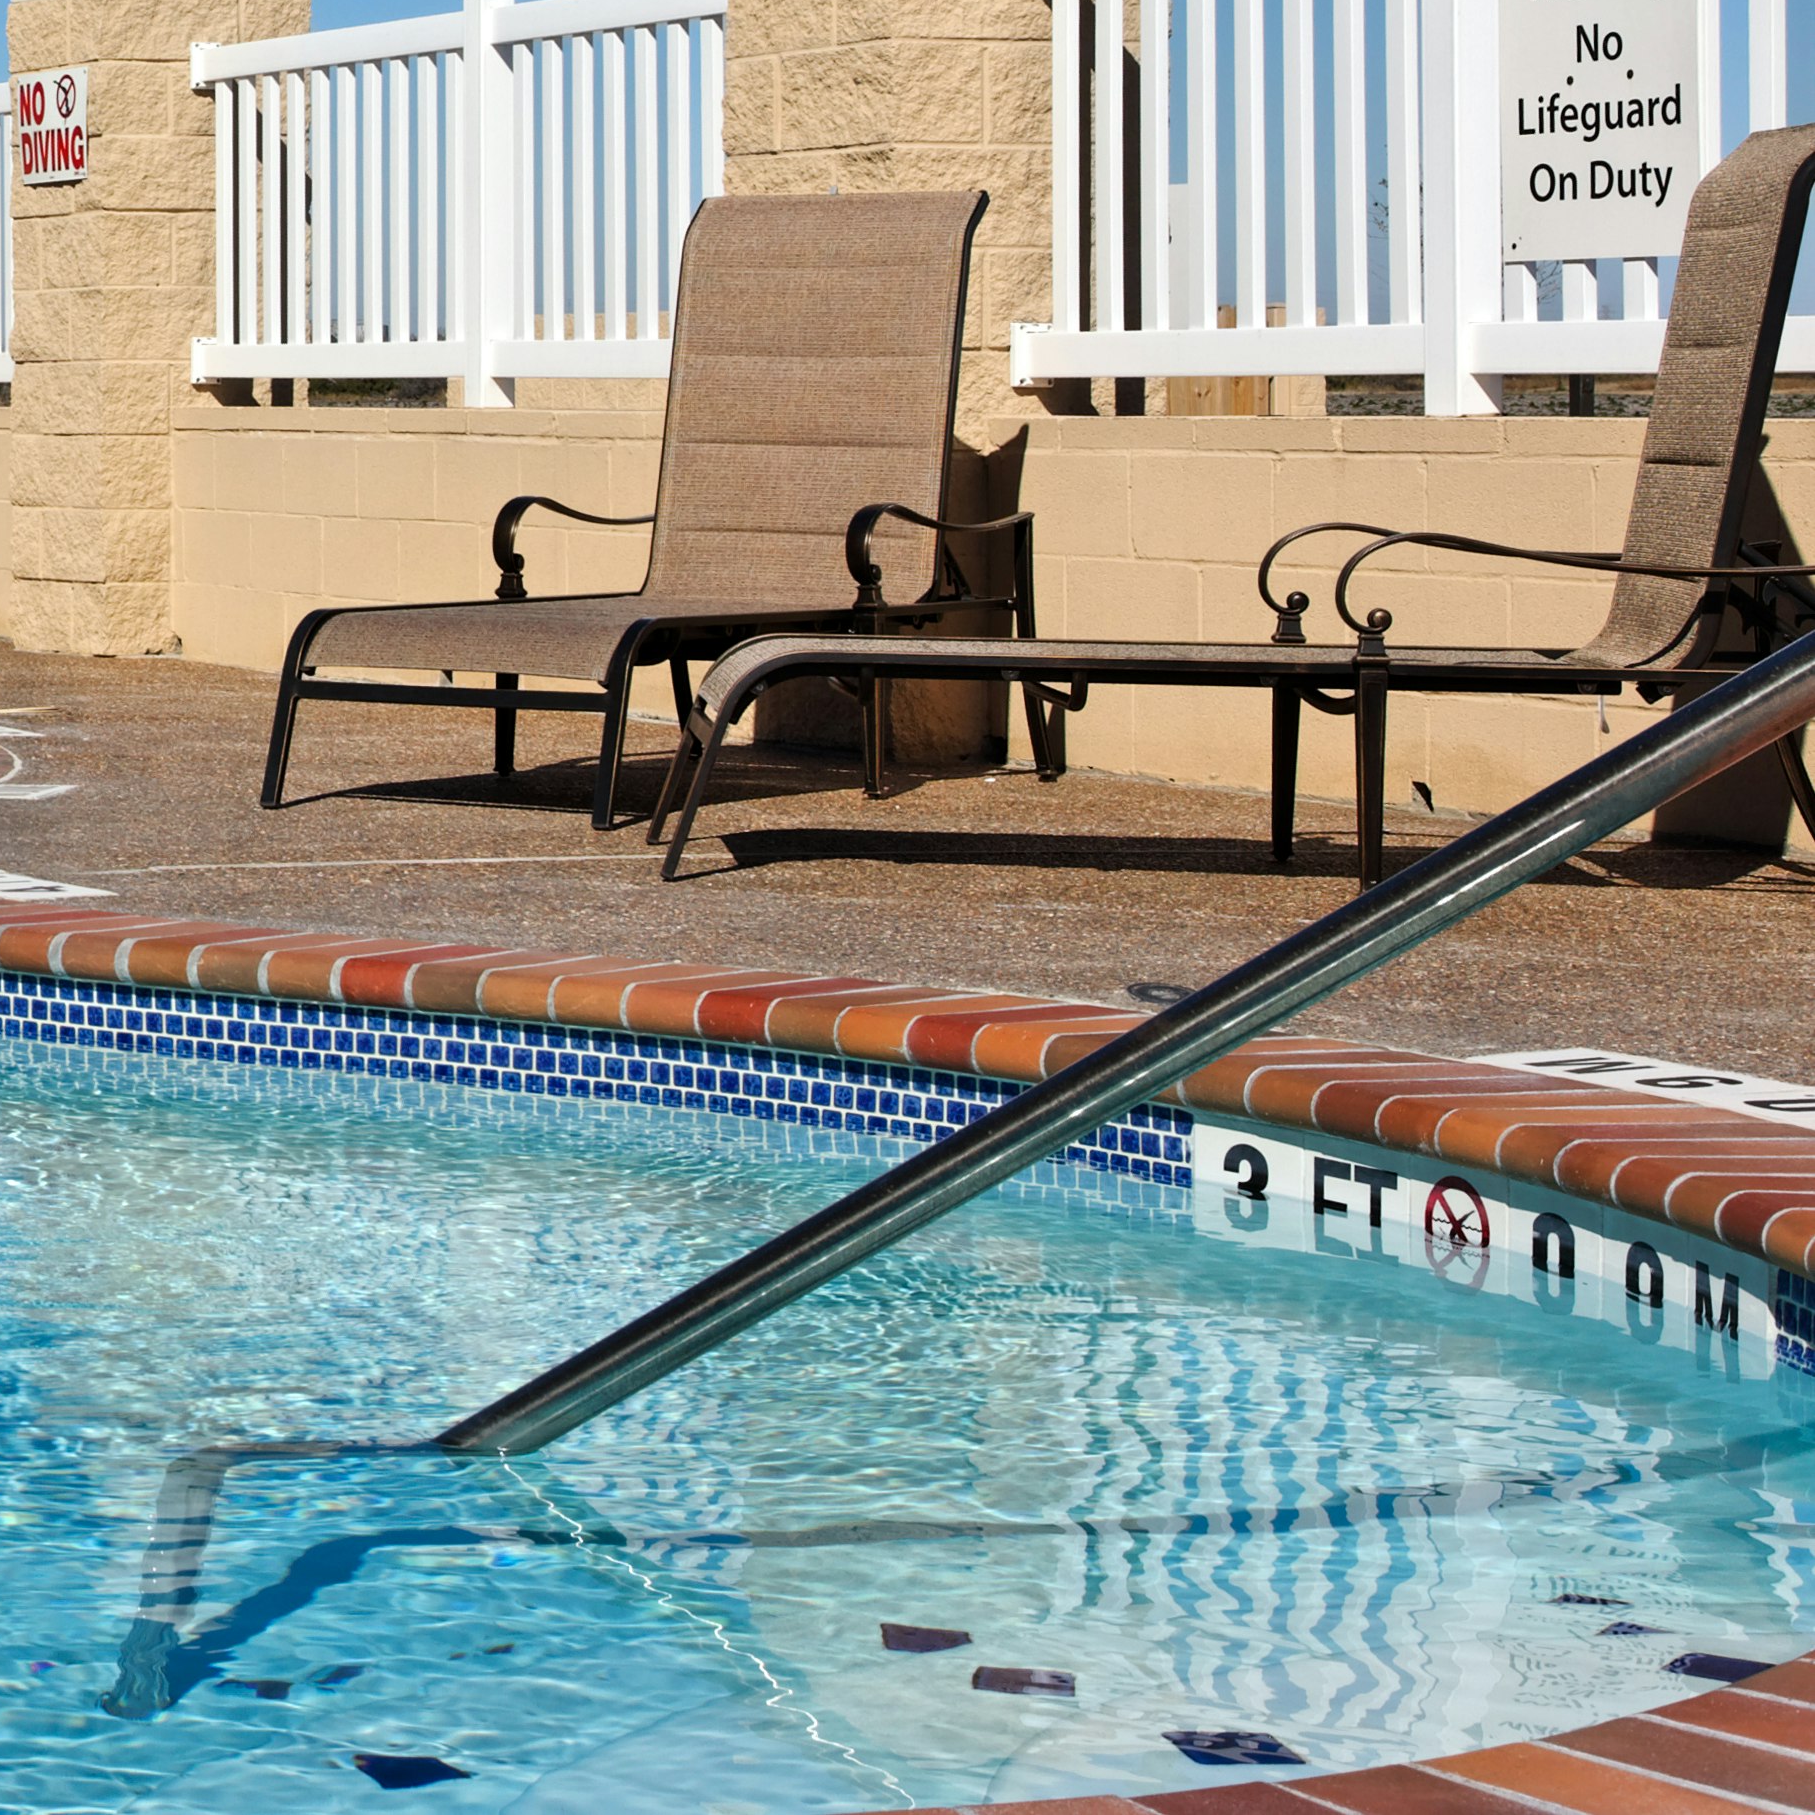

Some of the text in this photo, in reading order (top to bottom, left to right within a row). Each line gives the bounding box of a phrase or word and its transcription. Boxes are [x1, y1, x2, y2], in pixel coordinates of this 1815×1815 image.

[1575, 23, 1623, 63] No
[20, 81, 45, 126] NO
[1518, 83, 1682, 142] Lifeguard
[21, 125, 84, 175] DIVING
[1529, 160, 1673, 207] On Duty
[1314, 1156, 1398, 1228] FT
